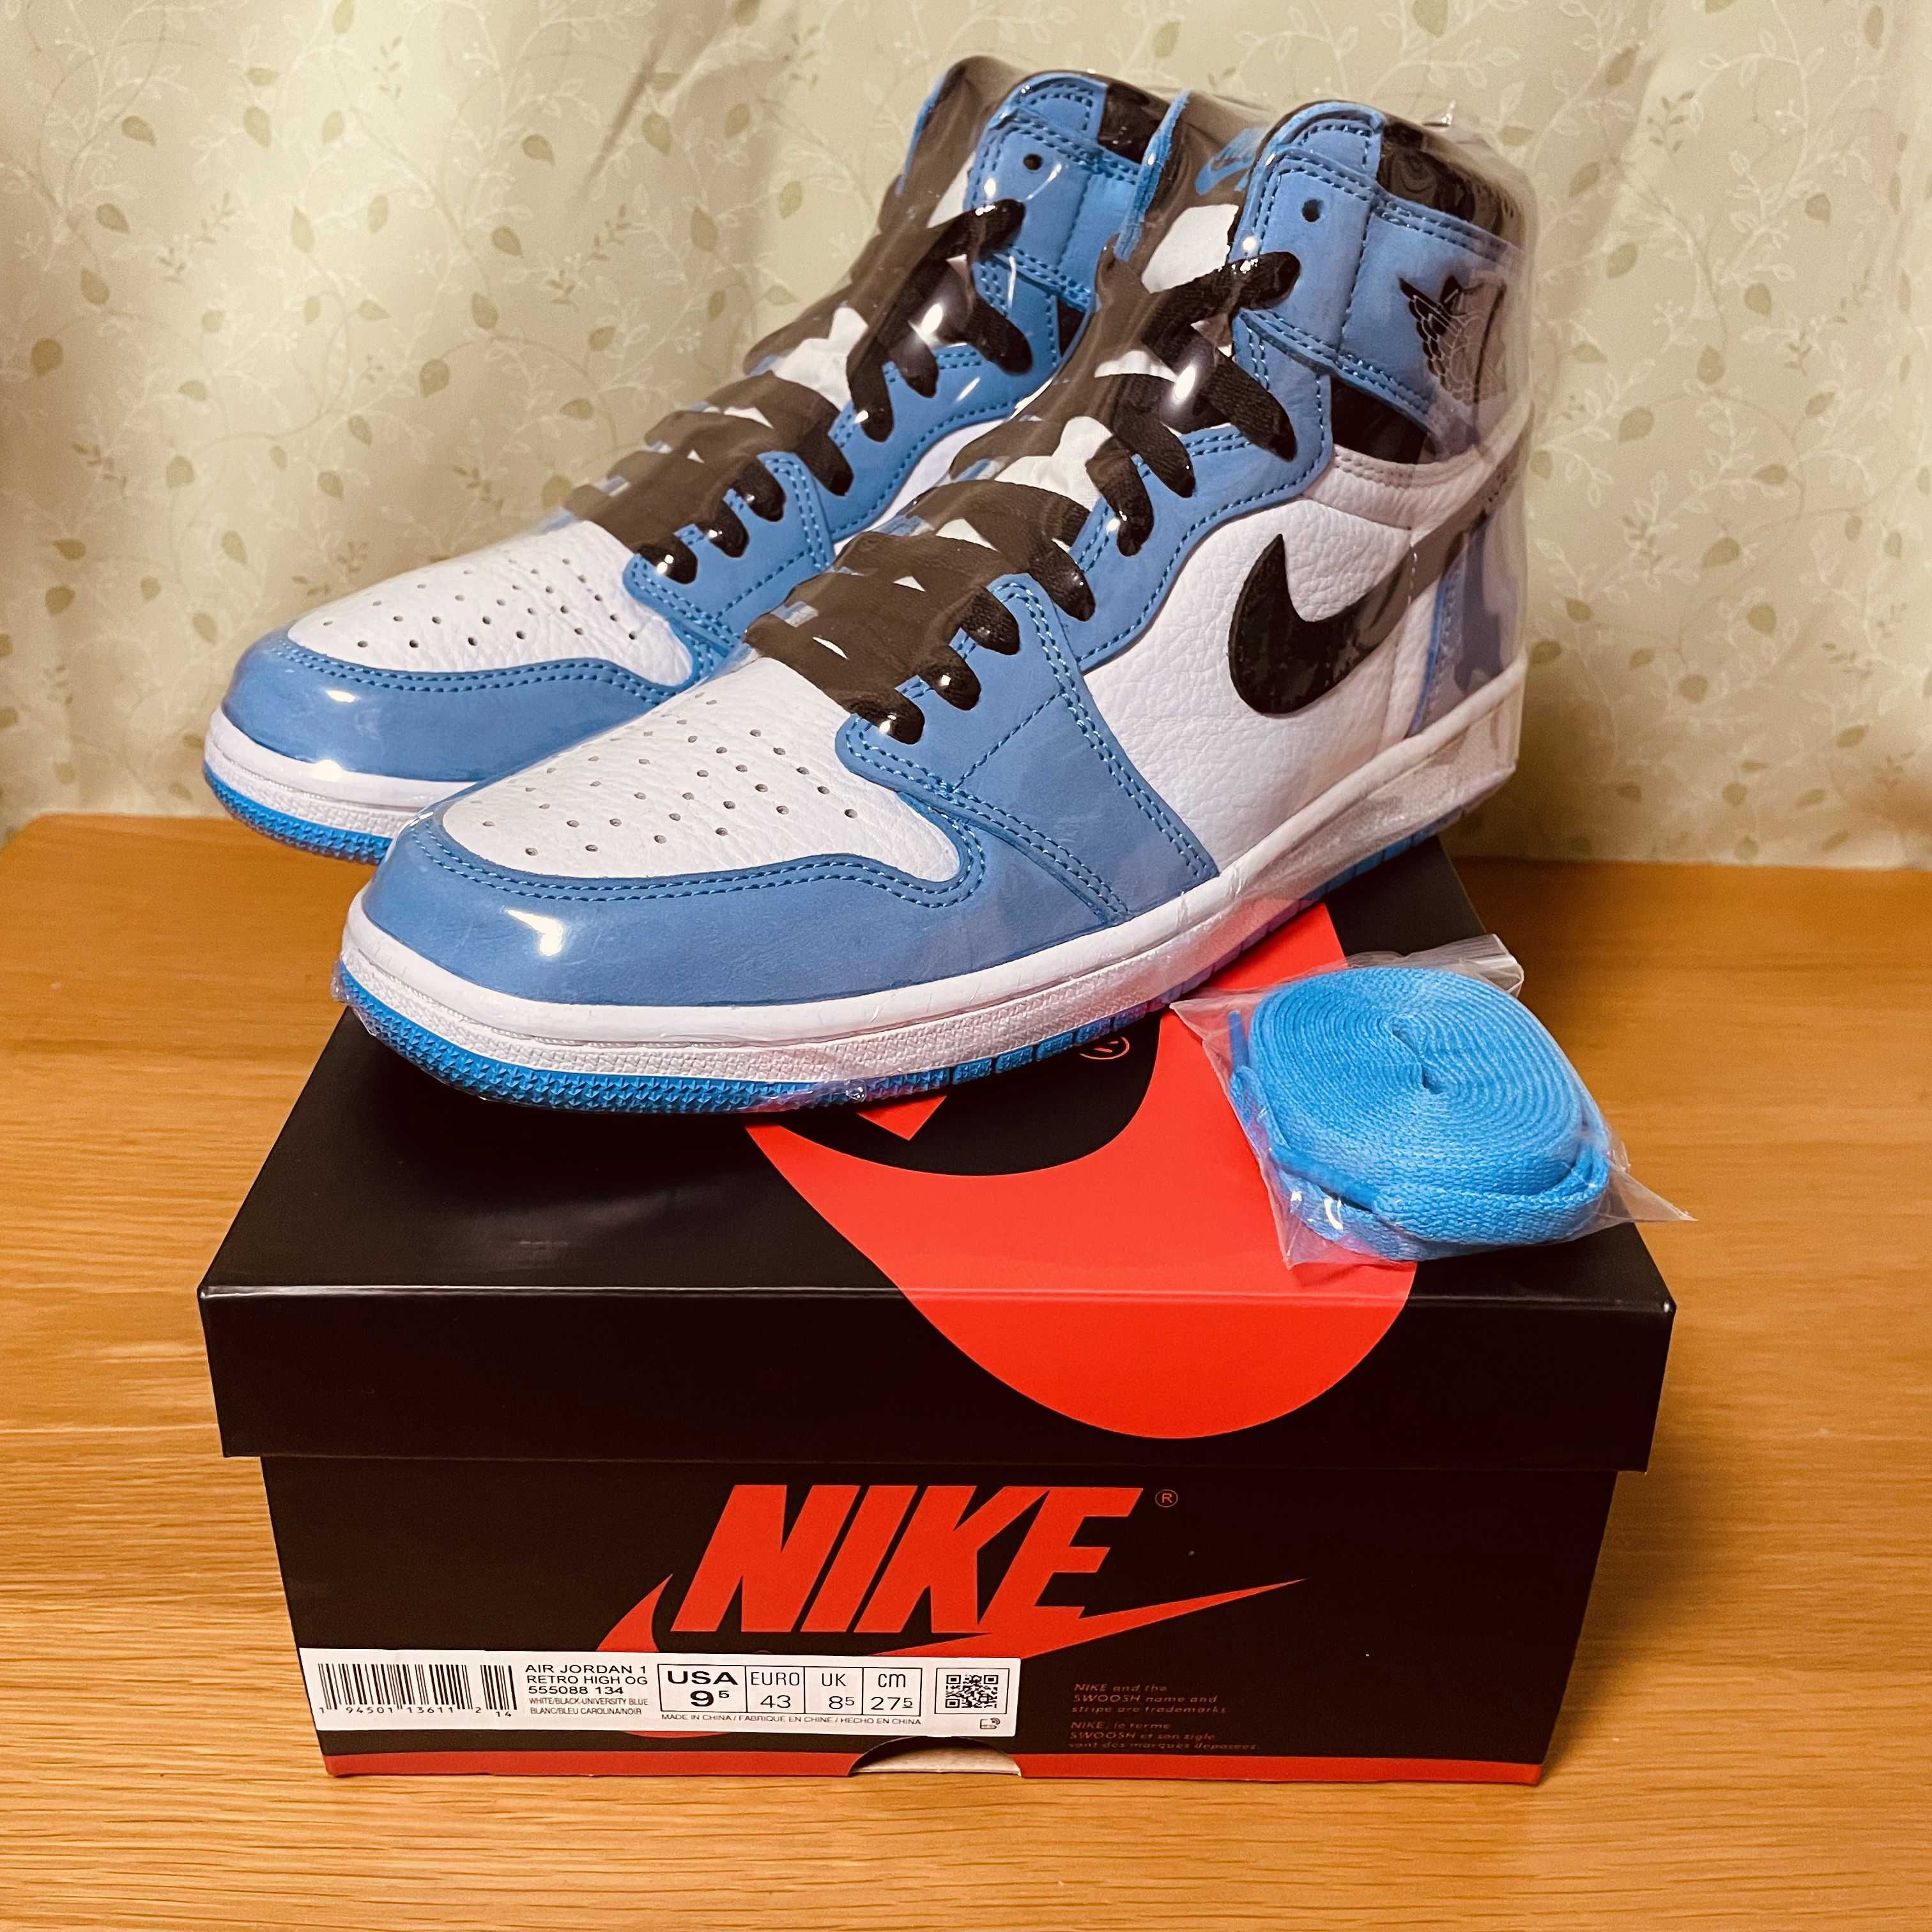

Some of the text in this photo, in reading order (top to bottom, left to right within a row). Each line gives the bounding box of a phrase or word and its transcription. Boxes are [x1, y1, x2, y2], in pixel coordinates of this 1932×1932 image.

[671, 1484, 1143, 1634] NIKE
[525, 1664, 646, 1674] AIR JORDAN 1
[526, 1675, 648, 1685] RETRO HIGH OG
[668, 1670, 739, 1685] USA
[751, 1671, 800, 1686] EURO
[822, 1673, 847, 1687] UK
[528, 1686, 624, 1695] 555088 134
[1073, 1683, 1108, 1692] NIKE
[1144, 1683, 1167, 1692] the
[629, 1698, 649, 1706] BLUE
[760, 1694, 792, 1708] 43
[1073, 1694, 1140, 1703] SWOOSH
[1190, 1695, 1218, 1703] and
[580, 1707, 642, 1715] CAROLINA/NOIR
